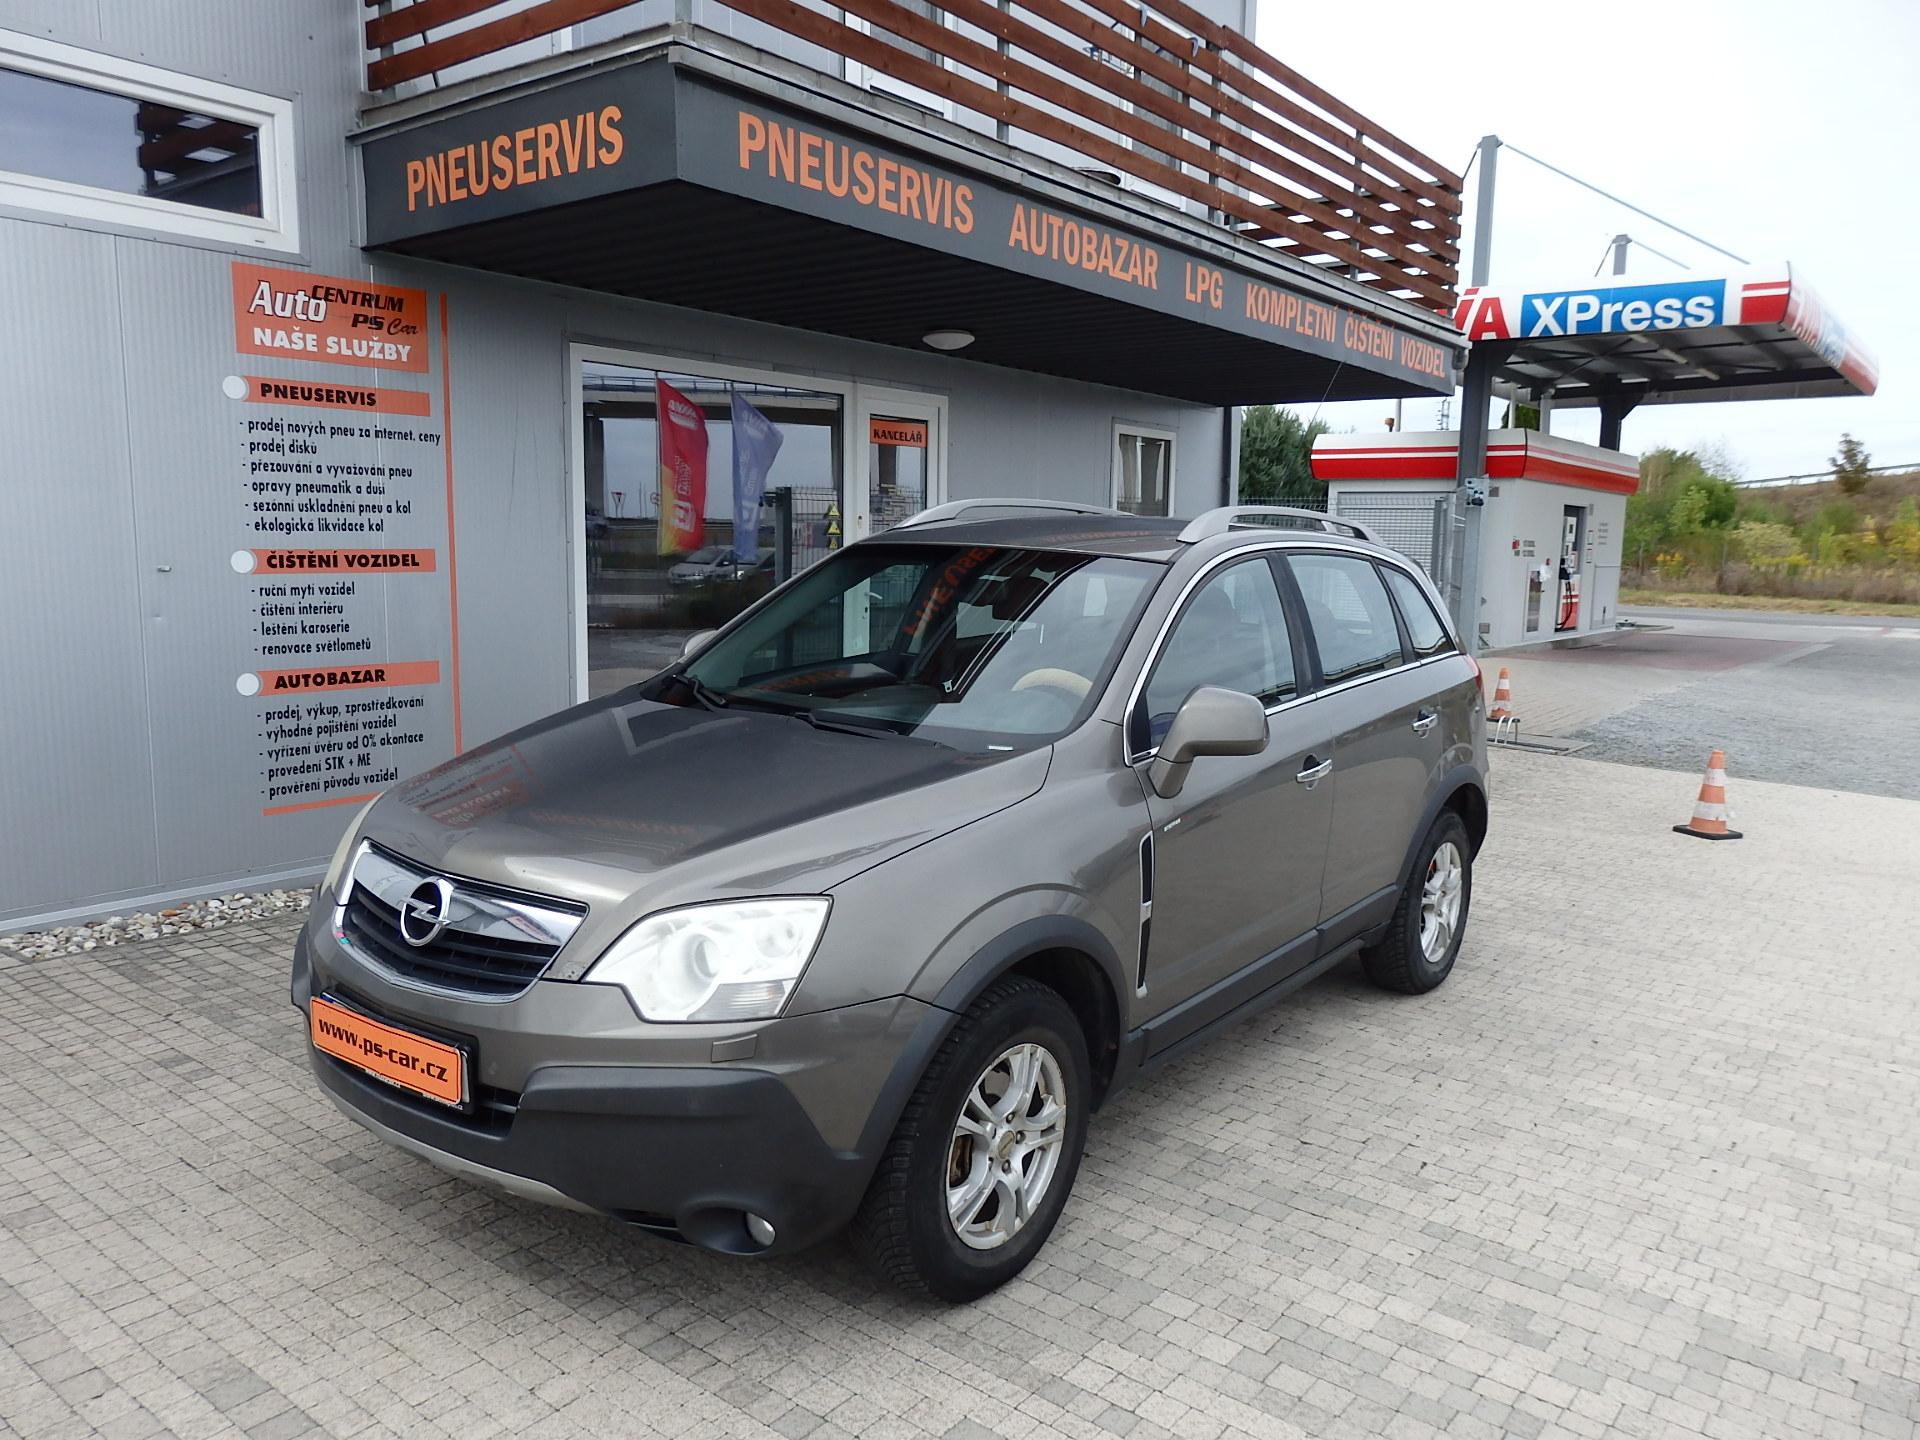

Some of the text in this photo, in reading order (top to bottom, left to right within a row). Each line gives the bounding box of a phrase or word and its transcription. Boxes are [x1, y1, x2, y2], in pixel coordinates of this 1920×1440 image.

[406, 104, 625, 212] PNEUSERVIS
[738, 110, 975, 235] PNEUSERVIS
[1008, 203, 1159, 291] AUTOBAZAR
[1184, 261, 1223, 311] LPG
[1245, 282, 1338, 344] KOMPLETNÍ
[1400, 336, 1446, 379] VOZIDEL
[248, 280, 404, 323] Auto CENTRUM
[351, 313, 419, 336] PS Car
[1530, 294, 1715, 338] XPress
[253, 326, 412, 363] NAŠE SLUŽBY
[260, 383, 377, 407] PNEUSERVIS
[248, 417, 441, 447] prodej nových pneu za internet. ceny
[872, 427, 923, 444] KANCELÁŘ
[249, 437, 285, 456] prodej
[251, 459, 312, 475] přezouvání
[316, 464, 323, 473] a
[388, 465, 412, 480] pneu
[252, 482, 291, 496] opravy
[295, 479, 352, 496] pneumatik
[355, 484, 362, 494] a
[358, 504, 383, 516] pneu
[386, 504, 392, 514] a
[396, 499, 411, 514] kol
[254, 516, 384, 535] ekologická likvidace kol
[266, 550, 420, 569] ČIŠTĚNÍ VOZIDEL
[259, 583, 286, 597] ruční
[318, 581, 355, 596] vozidel
[260, 601, 344, 617] čištění interiéru
[261, 619, 350, 636] leštění karoserie
[262, 637, 371, 655] renovace světlometů
[274, 669, 386, 690] AUTOBAZAR
[265, 695, 424, 725] prodej, výkup, zprostředkování
[266, 714, 397, 743] výhodné pojištění vozidel
[267, 742, 311, 763] vyřízení
[346, 736, 359, 750] od
[362, 734, 377, 748] 0%
[379, 732, 424, 746] akontace
[268, 760, 322, 782] provedení
[325, 755, 345, 771] STK
[357, 752, 371, 767] ME
[269, 767, 398, 800] prověření původu vozidel
[318, 1018, 448, 1083] www.ps-car.cz
